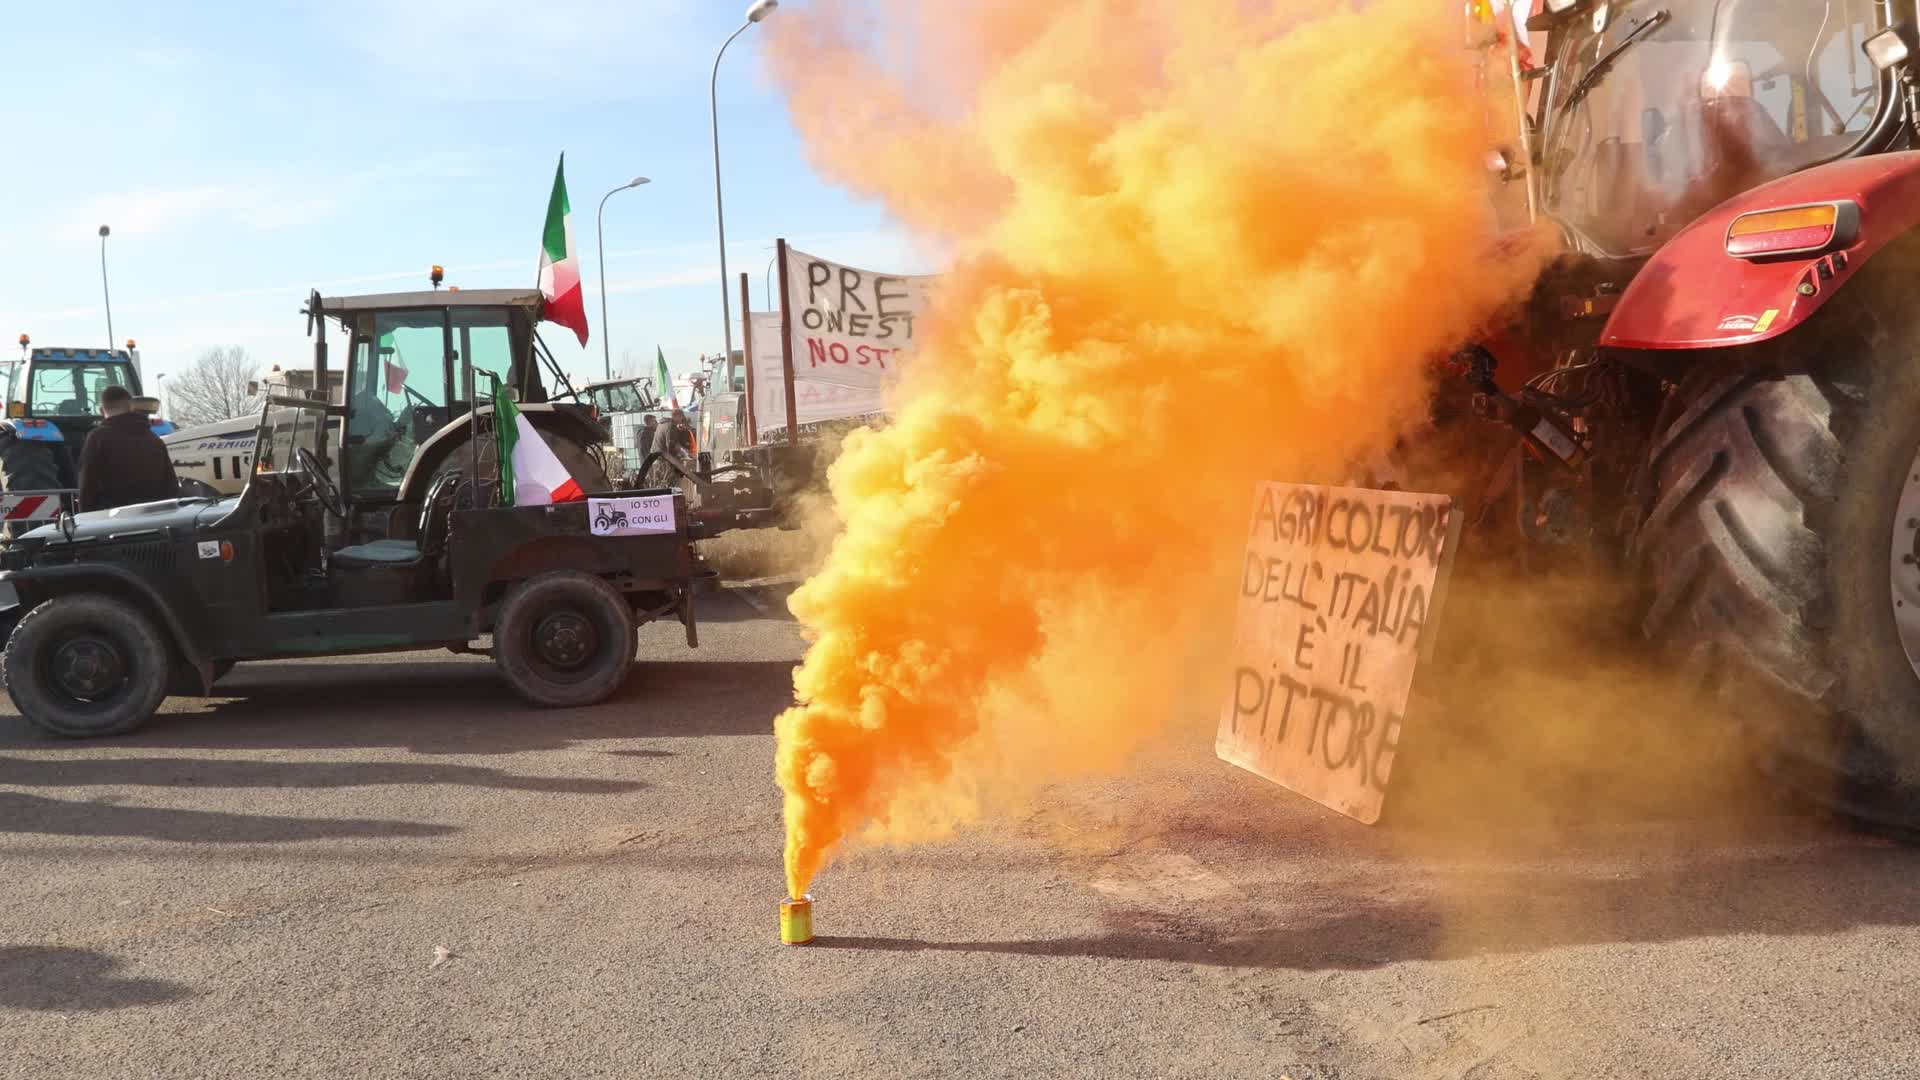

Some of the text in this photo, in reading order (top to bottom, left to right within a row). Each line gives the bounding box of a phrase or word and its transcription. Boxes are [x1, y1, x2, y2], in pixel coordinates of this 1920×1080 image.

[807, 262, 912, 318] PRE
[802, 308, 915, 339] ONEST
[807, 337, 901, 368] NO ST
[630, 500, 660, 509] IO STO
[631, 514, 668, 524] CON GLI
[1339, 643, 1367, 693] IL
